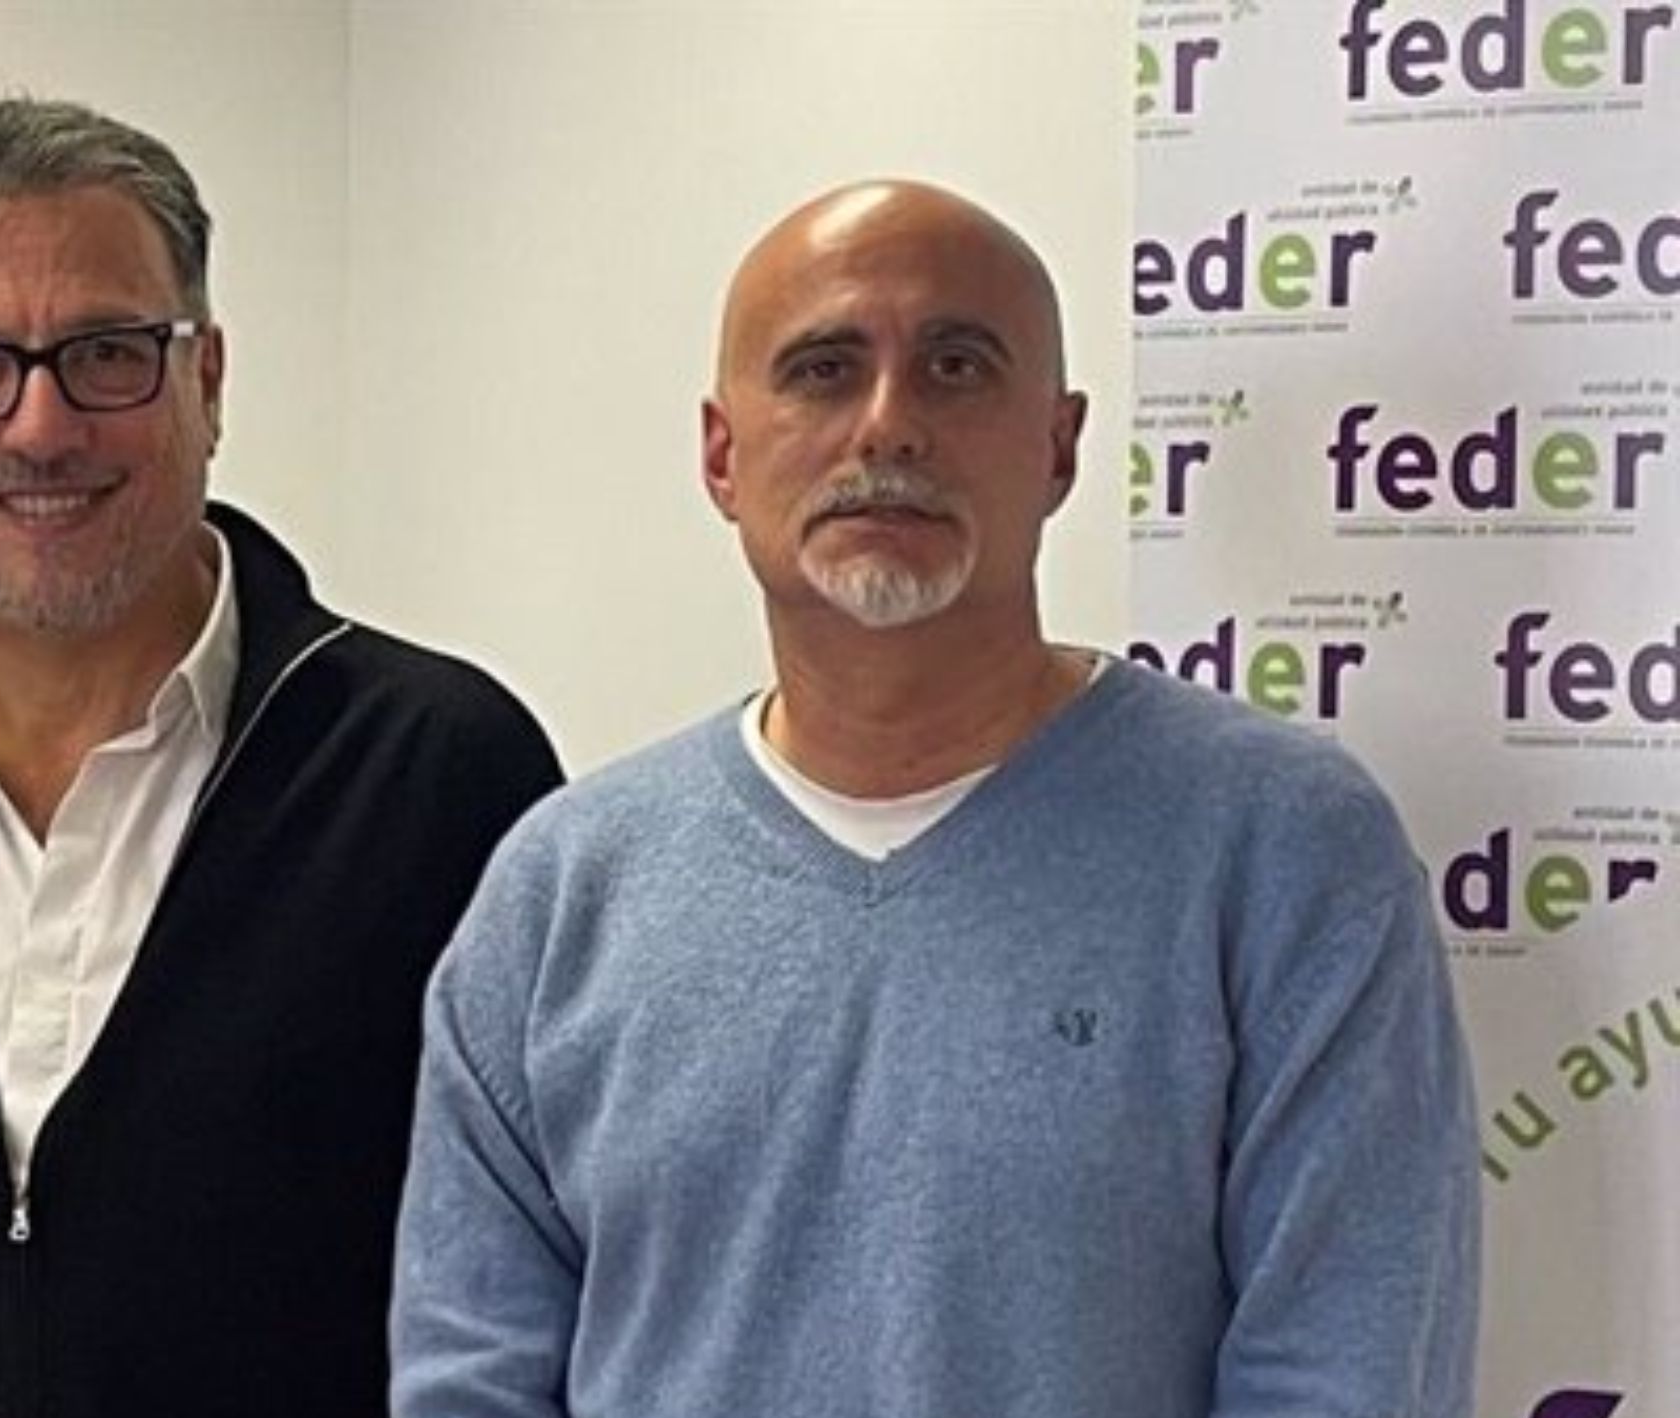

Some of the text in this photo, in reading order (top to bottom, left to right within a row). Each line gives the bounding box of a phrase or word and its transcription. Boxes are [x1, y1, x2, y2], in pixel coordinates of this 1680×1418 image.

[1339, 0, 1675, 99] feder
[1327, 405, 1665, 512] feder
[1444, 826, 1659, 931] der
